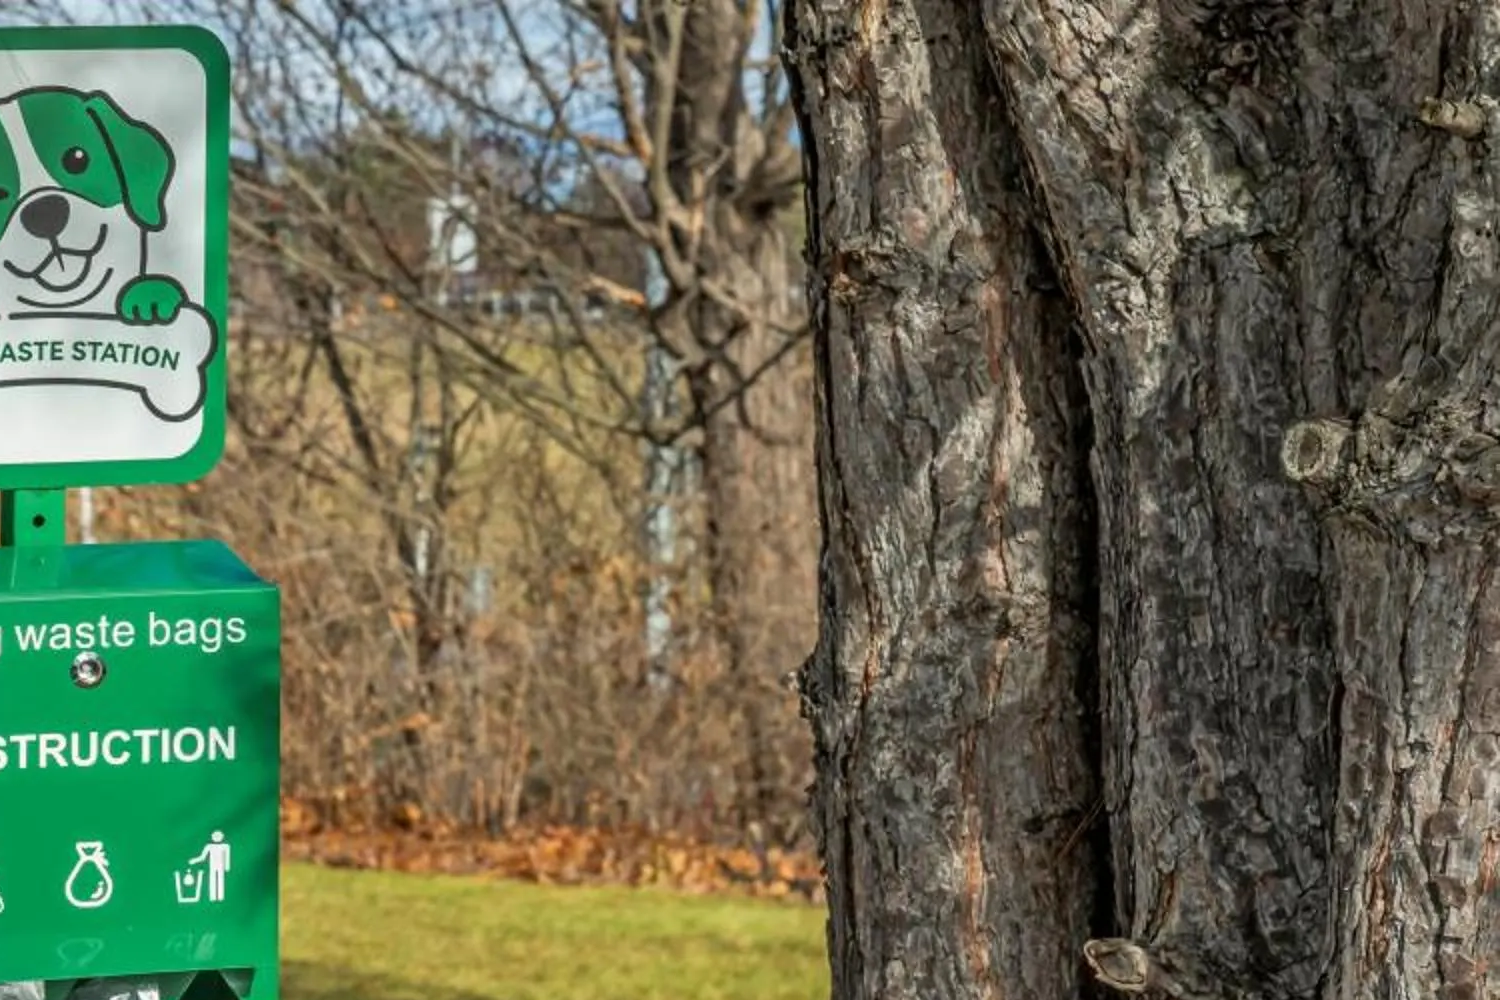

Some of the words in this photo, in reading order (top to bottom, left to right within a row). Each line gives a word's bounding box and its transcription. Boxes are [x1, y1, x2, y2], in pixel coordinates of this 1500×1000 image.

[72, 340, 181, 371] STATION
[13, 614, 136, 651] waste
[148, 611, 247, 653] bags
